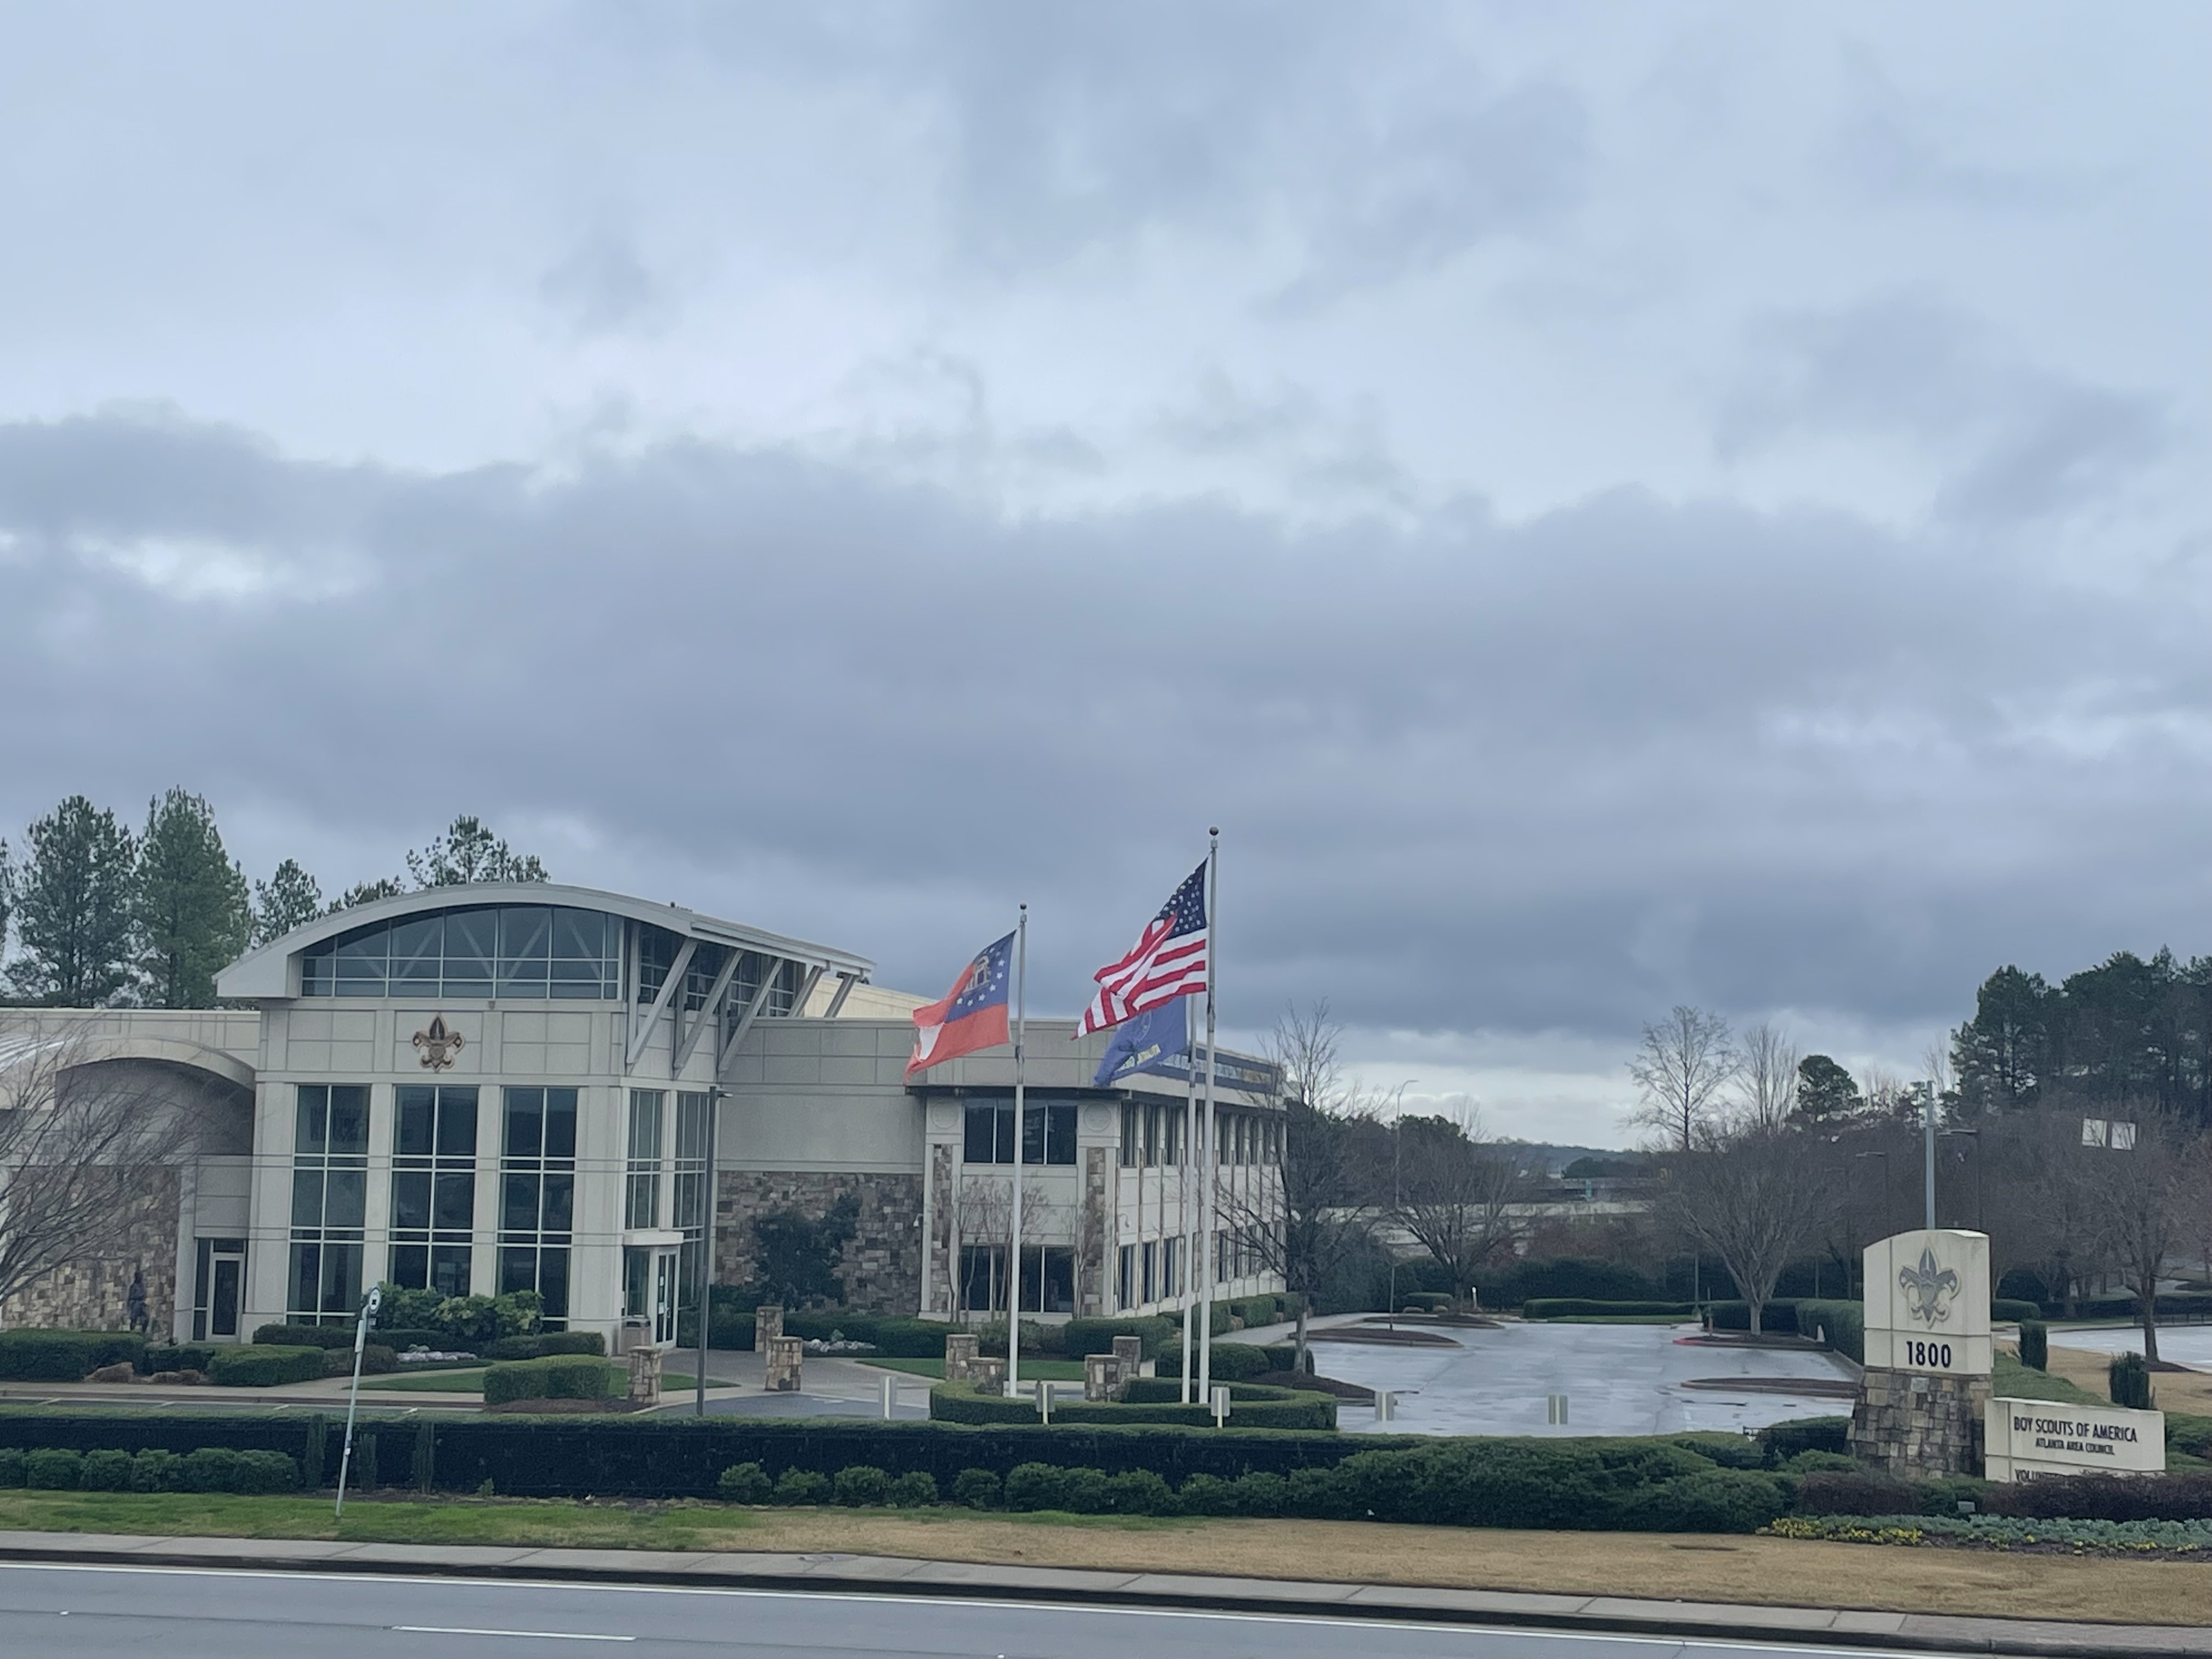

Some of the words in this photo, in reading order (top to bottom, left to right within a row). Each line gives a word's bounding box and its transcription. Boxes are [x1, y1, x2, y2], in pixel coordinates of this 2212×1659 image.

[1906, 1341, 1951, 1368] 1800
[2014, 1416, 2033, 1431] BOY
[2035, 1418, 2073, 1436] SCOUTS
[2076, 1422, 2090, 1437] OF
[2092, 1423, 2137, 1442] AMERICA
[2067, 1440, 2084, 1452] AREA
[2086, 1442, 2115, 1455] COUNCIL
